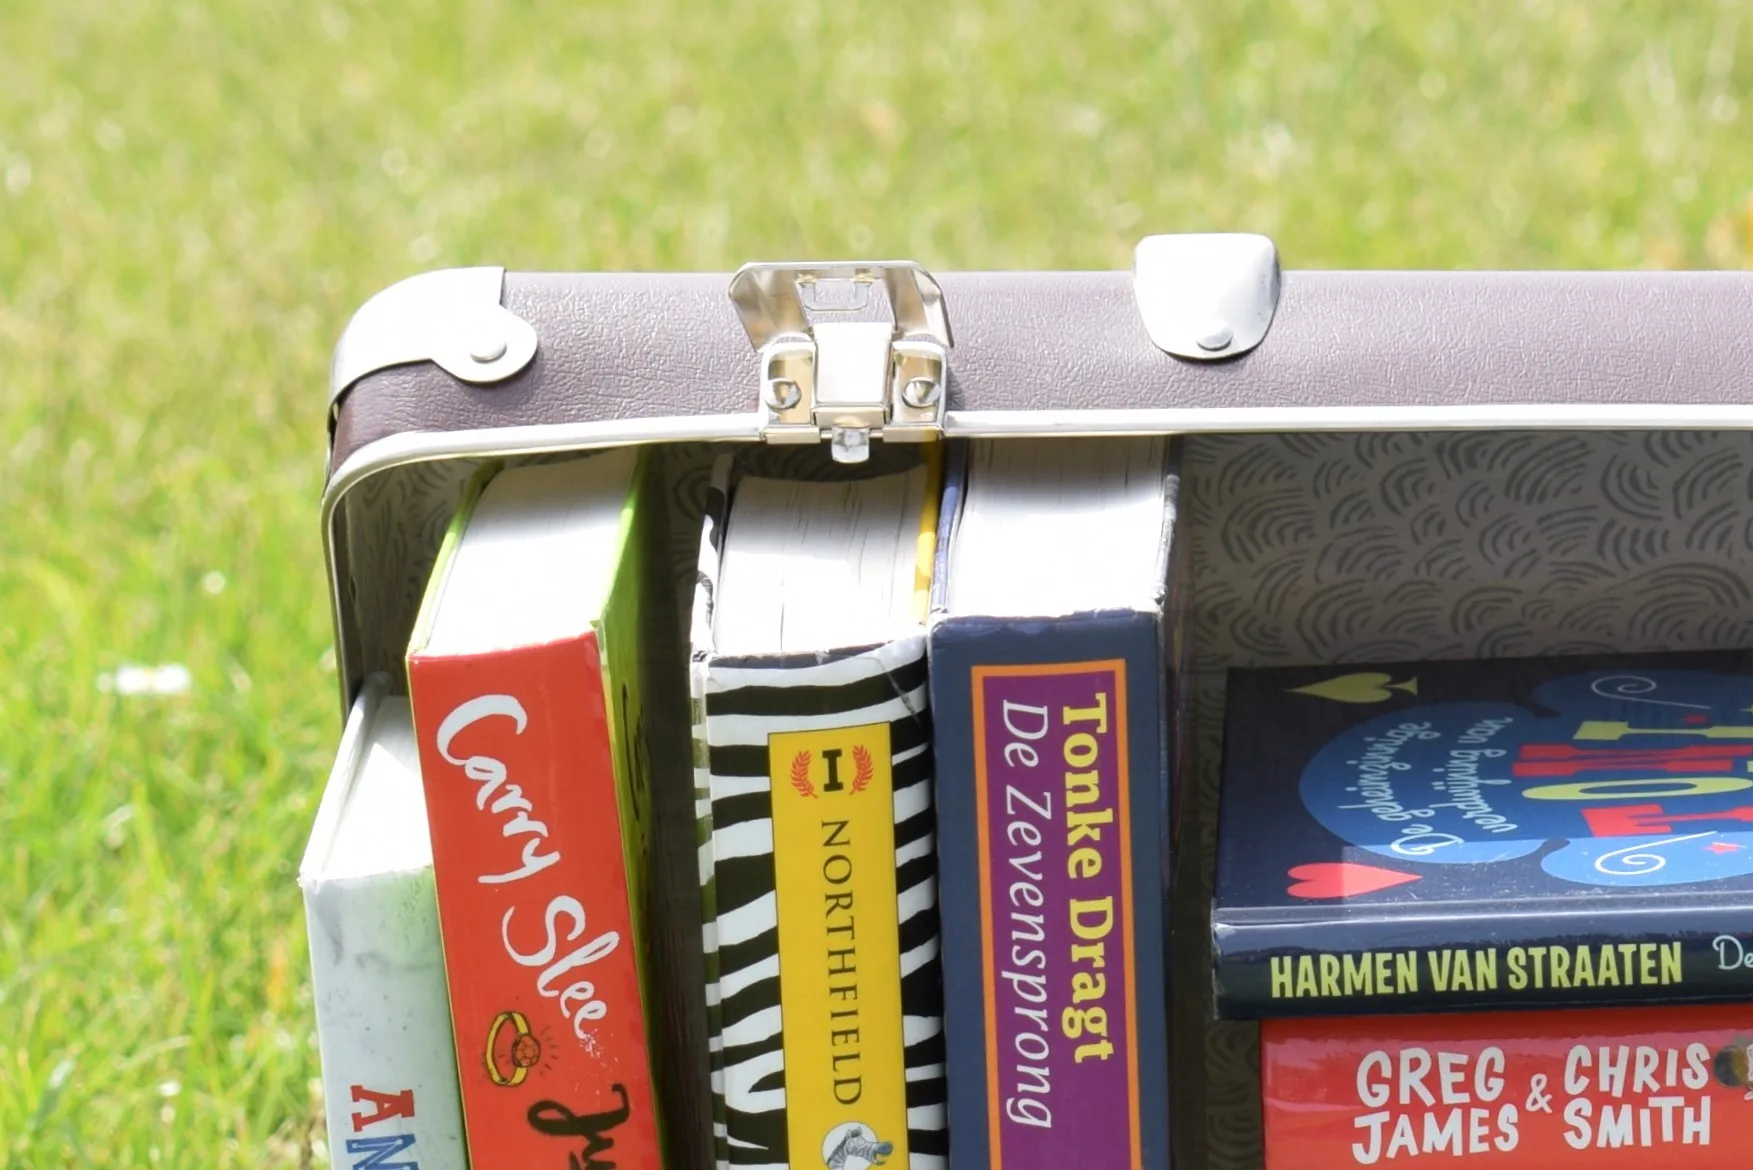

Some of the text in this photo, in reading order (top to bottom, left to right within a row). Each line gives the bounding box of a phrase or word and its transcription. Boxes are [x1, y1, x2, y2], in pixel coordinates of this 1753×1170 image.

[821, 748, 843, 792] I
[1338, 721, 1464, 855] De geheimzinnige
[1429, 716, 1518, 833] verdwijning van
[437, 694, 619, 1041] Carry Slee
[1061, 692, 1114, 1063] Tonke Dragt
[1001, 699, 1052, 1128] De Zevensprong
[821, 819, 862, 1105] NORTHFIELD
[1270, 941, 1683, 998] HARMEN VAN STRAATEN
[1356, 1045, 1506, 1108] GREG
[1525, 1073, 1553, 1114] &
[1563, 1043, 1711, 1098] CHRIS
[1352, 1103, 1520, 1165] JAMES
[1563, 1095, 1711, 1151] SMITH
